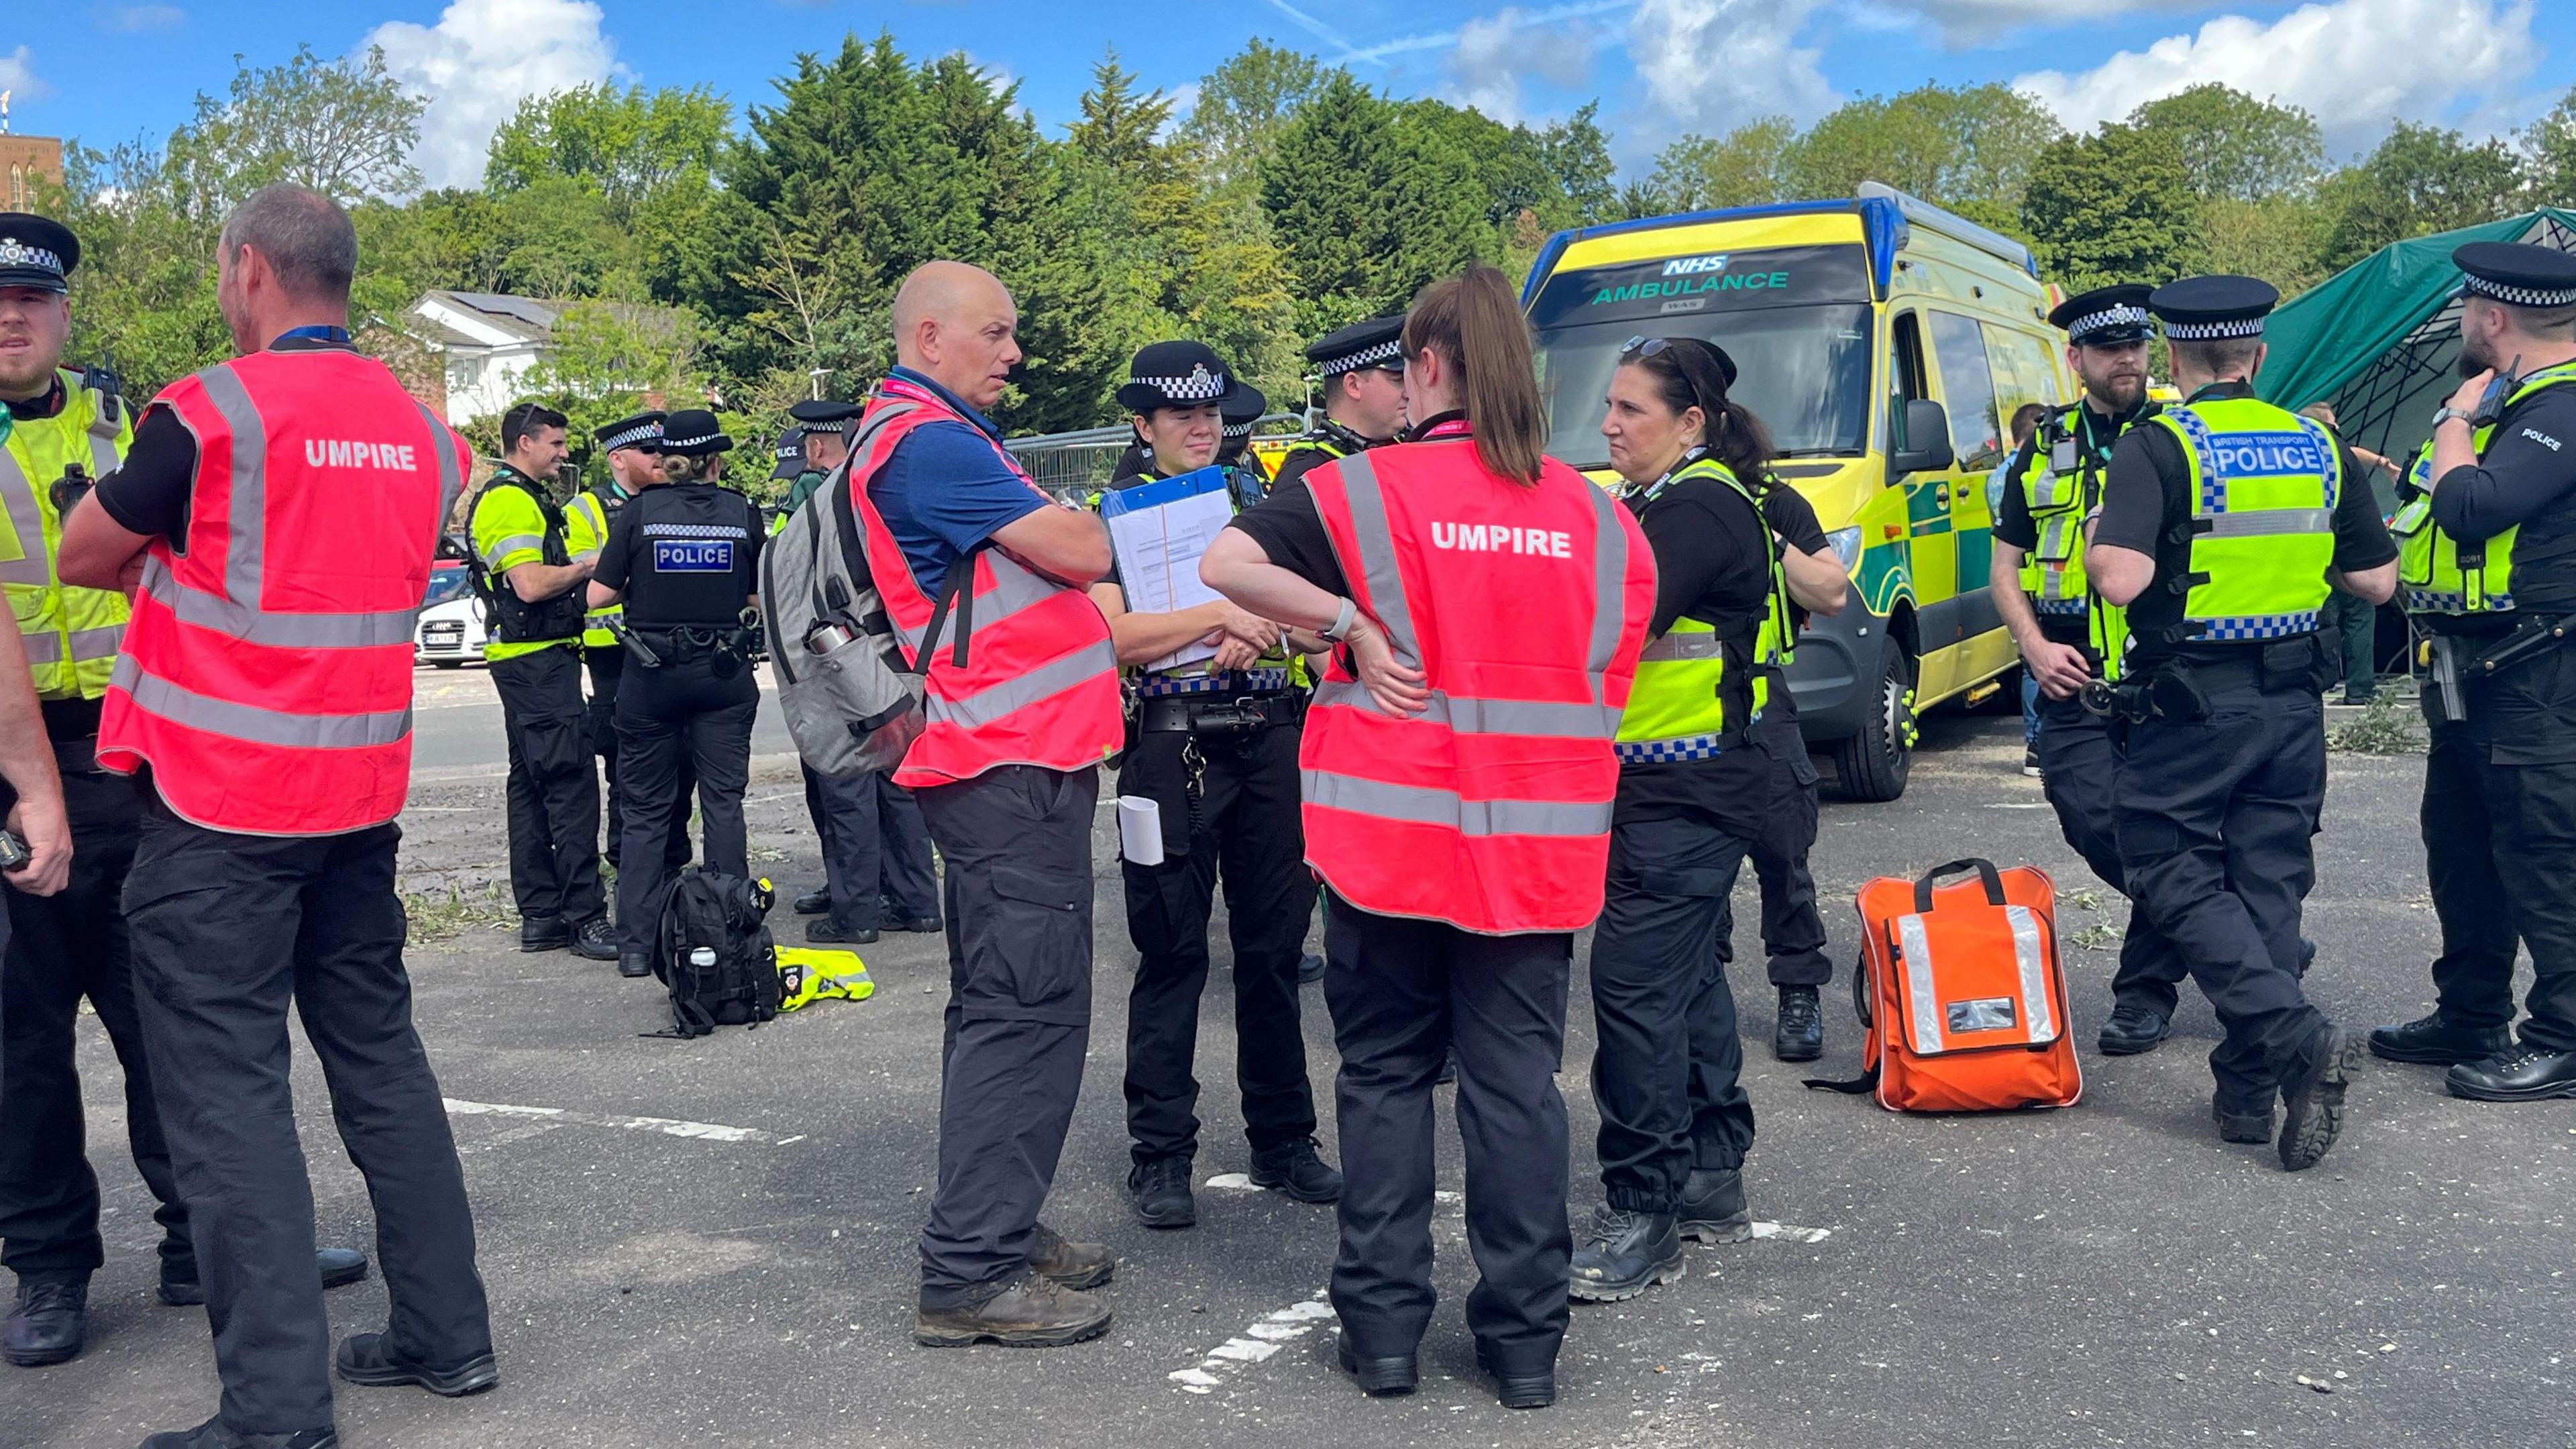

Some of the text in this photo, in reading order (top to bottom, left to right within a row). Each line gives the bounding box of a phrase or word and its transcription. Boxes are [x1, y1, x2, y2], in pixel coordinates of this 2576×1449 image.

[1664, 256, 1727, 276] NHS
[1592, 272, 1789, 305] AMBULANCE
[2212, 436, 2310, 447] BRITISH TRANSPORT
[2522, 428, 2561, 451] POLICE
[305, 439, 417, 472] UMPIRE
[2216, 446, 2321, 472] POLICE
[1431, 521, 1572, 559] UMPIRE
[659, 548, 728, 564] POLICE
